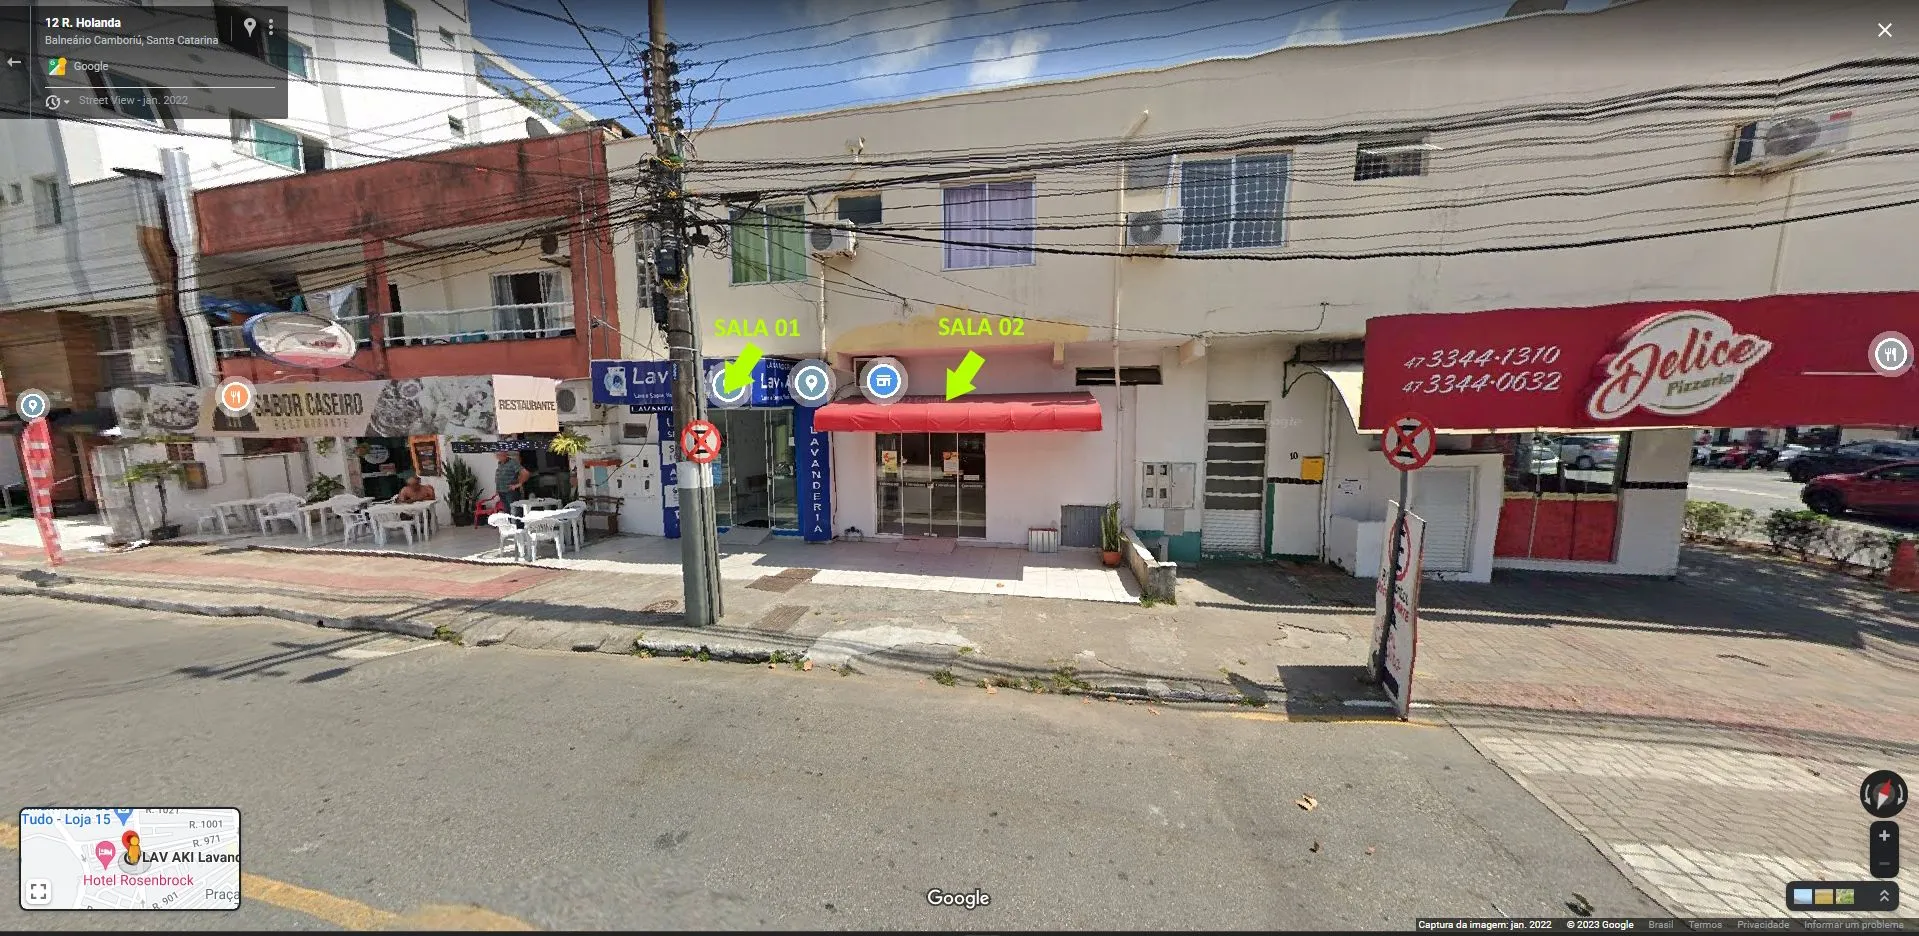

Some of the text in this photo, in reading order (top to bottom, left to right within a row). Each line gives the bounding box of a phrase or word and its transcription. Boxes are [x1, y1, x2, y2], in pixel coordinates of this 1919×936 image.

[1404, 356, 1424, 368] 47
[632, 367, 669, 385] Lav
[1598, 328, 1759, 414] Delice
[760, 373, 780, 389] Lav
[1403, 381, 1423, 394] 47
[1667, 372, 1734, 397] Pizzaria
[255, 391, 364, 418] SABOR CASEIRO
[498, 398, 557, 412] RESTAURANTE
[1290, 451, 1299, 460] 10
[810, 426, 823, 533] LAVANDERIA
